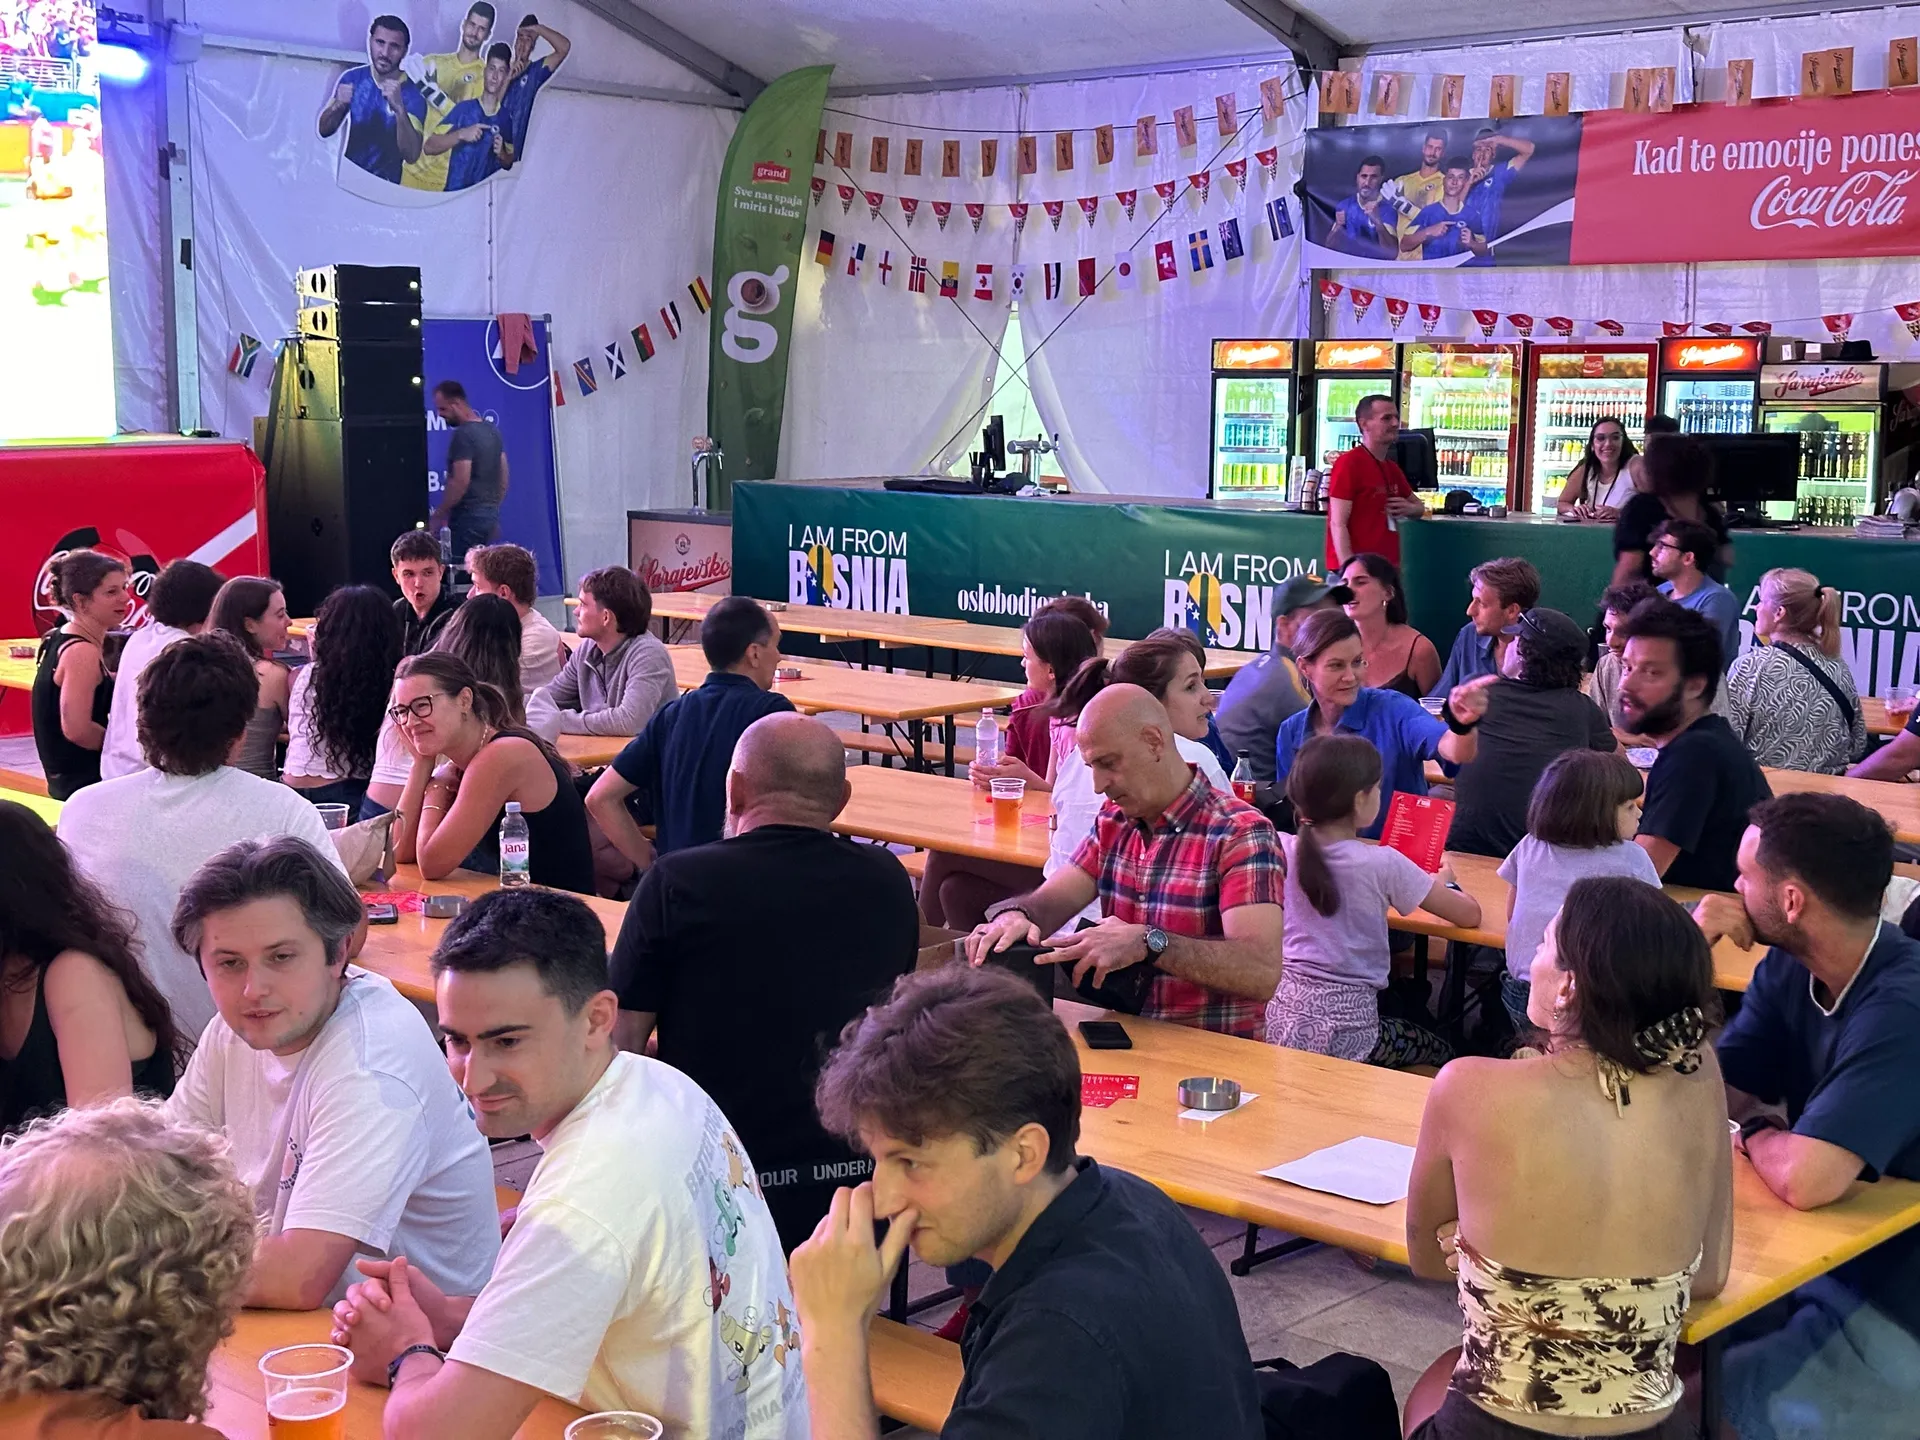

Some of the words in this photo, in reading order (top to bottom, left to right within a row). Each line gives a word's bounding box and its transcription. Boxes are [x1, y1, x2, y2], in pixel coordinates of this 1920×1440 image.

[1633, 136, 1683, 175] Kad
[1690, 139, 1716, 173] te
[1722, 130, 1832, 176] emocije
[757, 167, 787, 178] grand
[734, 185, 753, 197] Sve
[754, 191, 773, 201] nas
[774, 194, 803, 207] spaja
[739, 200, 767, 213] miris
[774, 206, 800, 219] ukus
[1750, 169, 1919, 230] Coca-Cola
[788, 523, 793, 547] I
[800, 525, 835, 552] AM
[842, 528, 908, 556] FROM
[788, 543, 910, 616] BOSNIA
[1164, 549, 1169, 576] I
[1179, 551, 1223, 580] AM
[1233, 554, 1317, 584] FROM
[1163, 571, 1274, 651] BOSN
[1838, 590, 1920, 628] ROM
[504, 843, 527, 854] Jana
[757, 1168, 798, 1188] OUR
